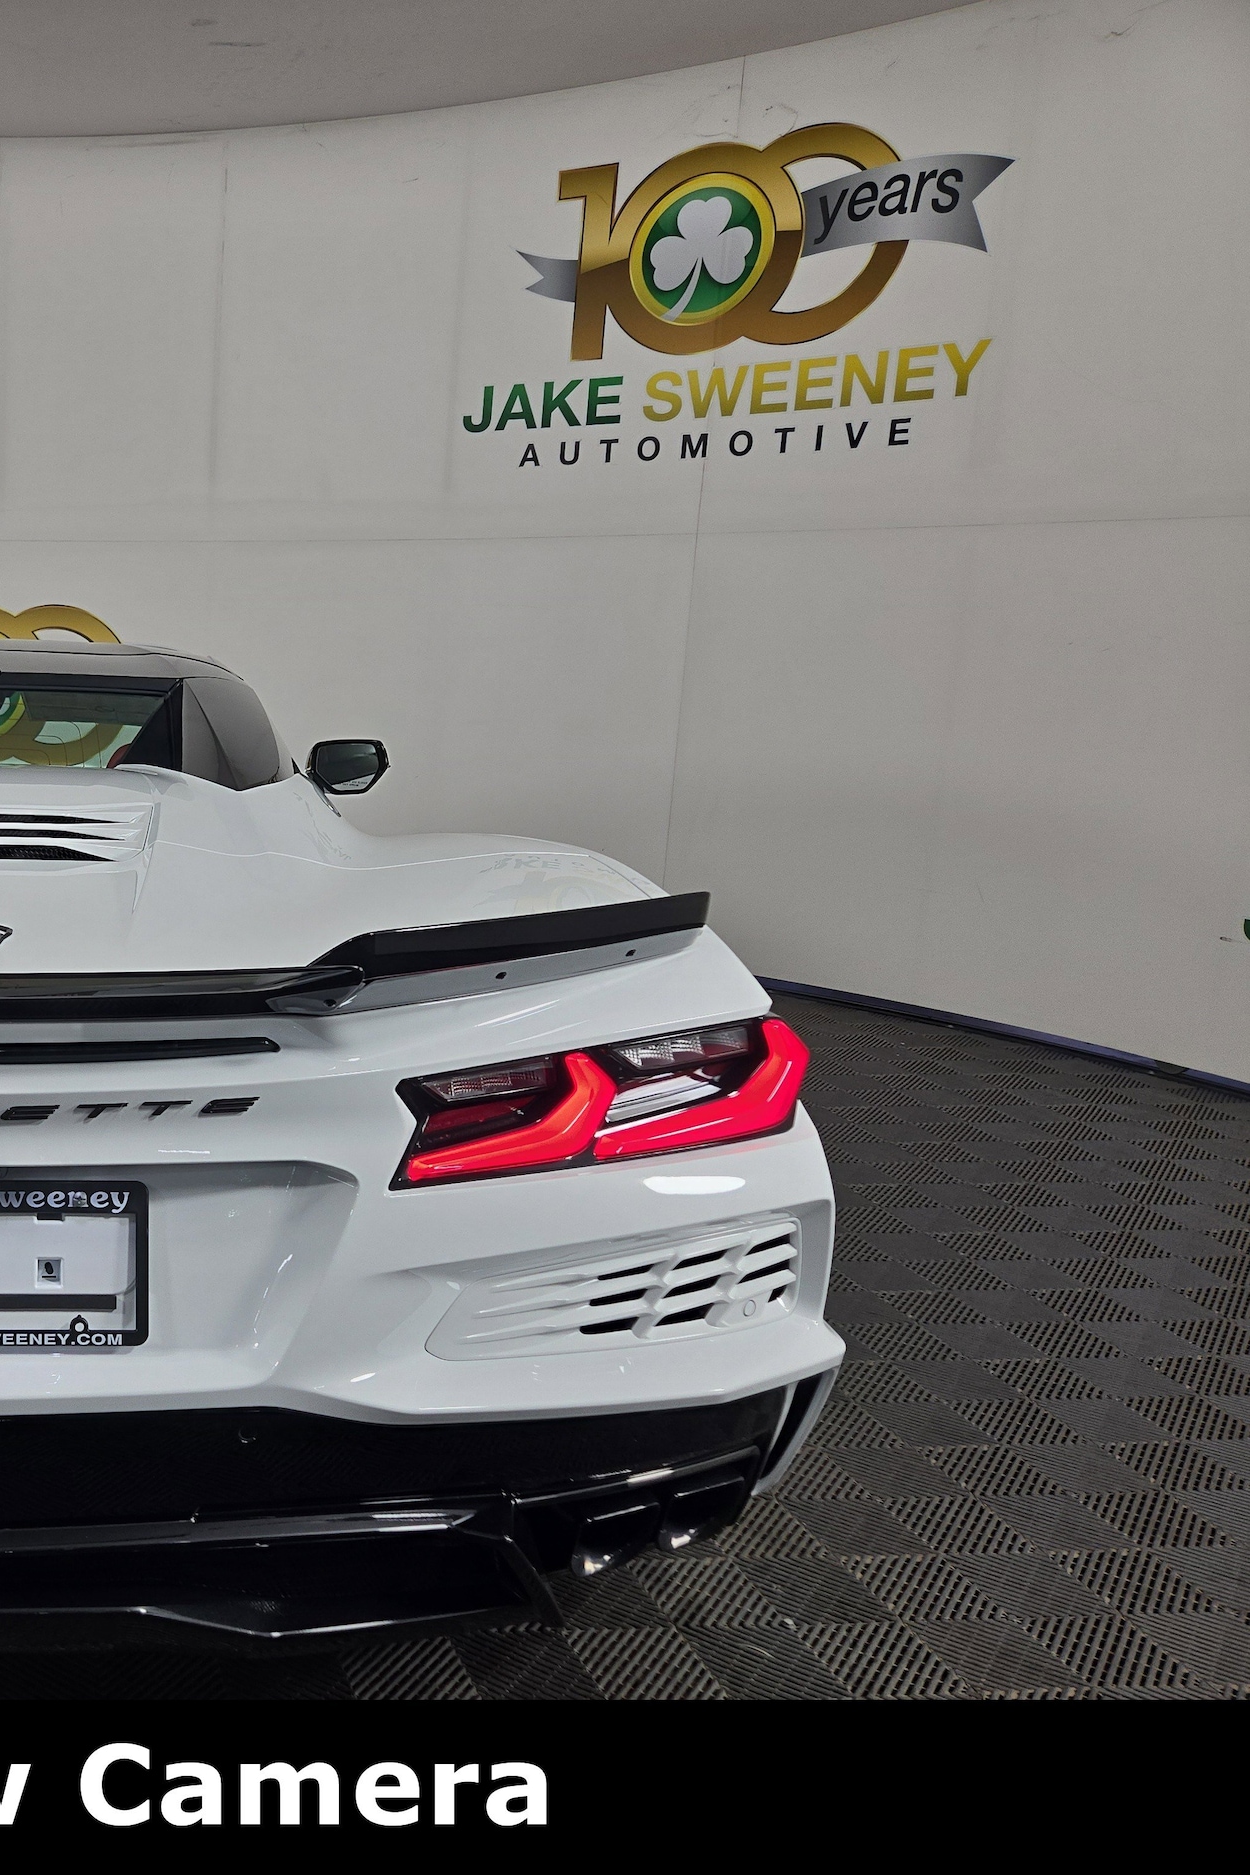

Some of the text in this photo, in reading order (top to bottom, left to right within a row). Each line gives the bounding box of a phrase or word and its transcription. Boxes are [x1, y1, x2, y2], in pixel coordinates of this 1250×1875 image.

[813, 167, 963, 245] years
[463, 338, 992, 434] JAKE SWEENEY
[518, 417, 913, 468] AUTOMOTIVE
